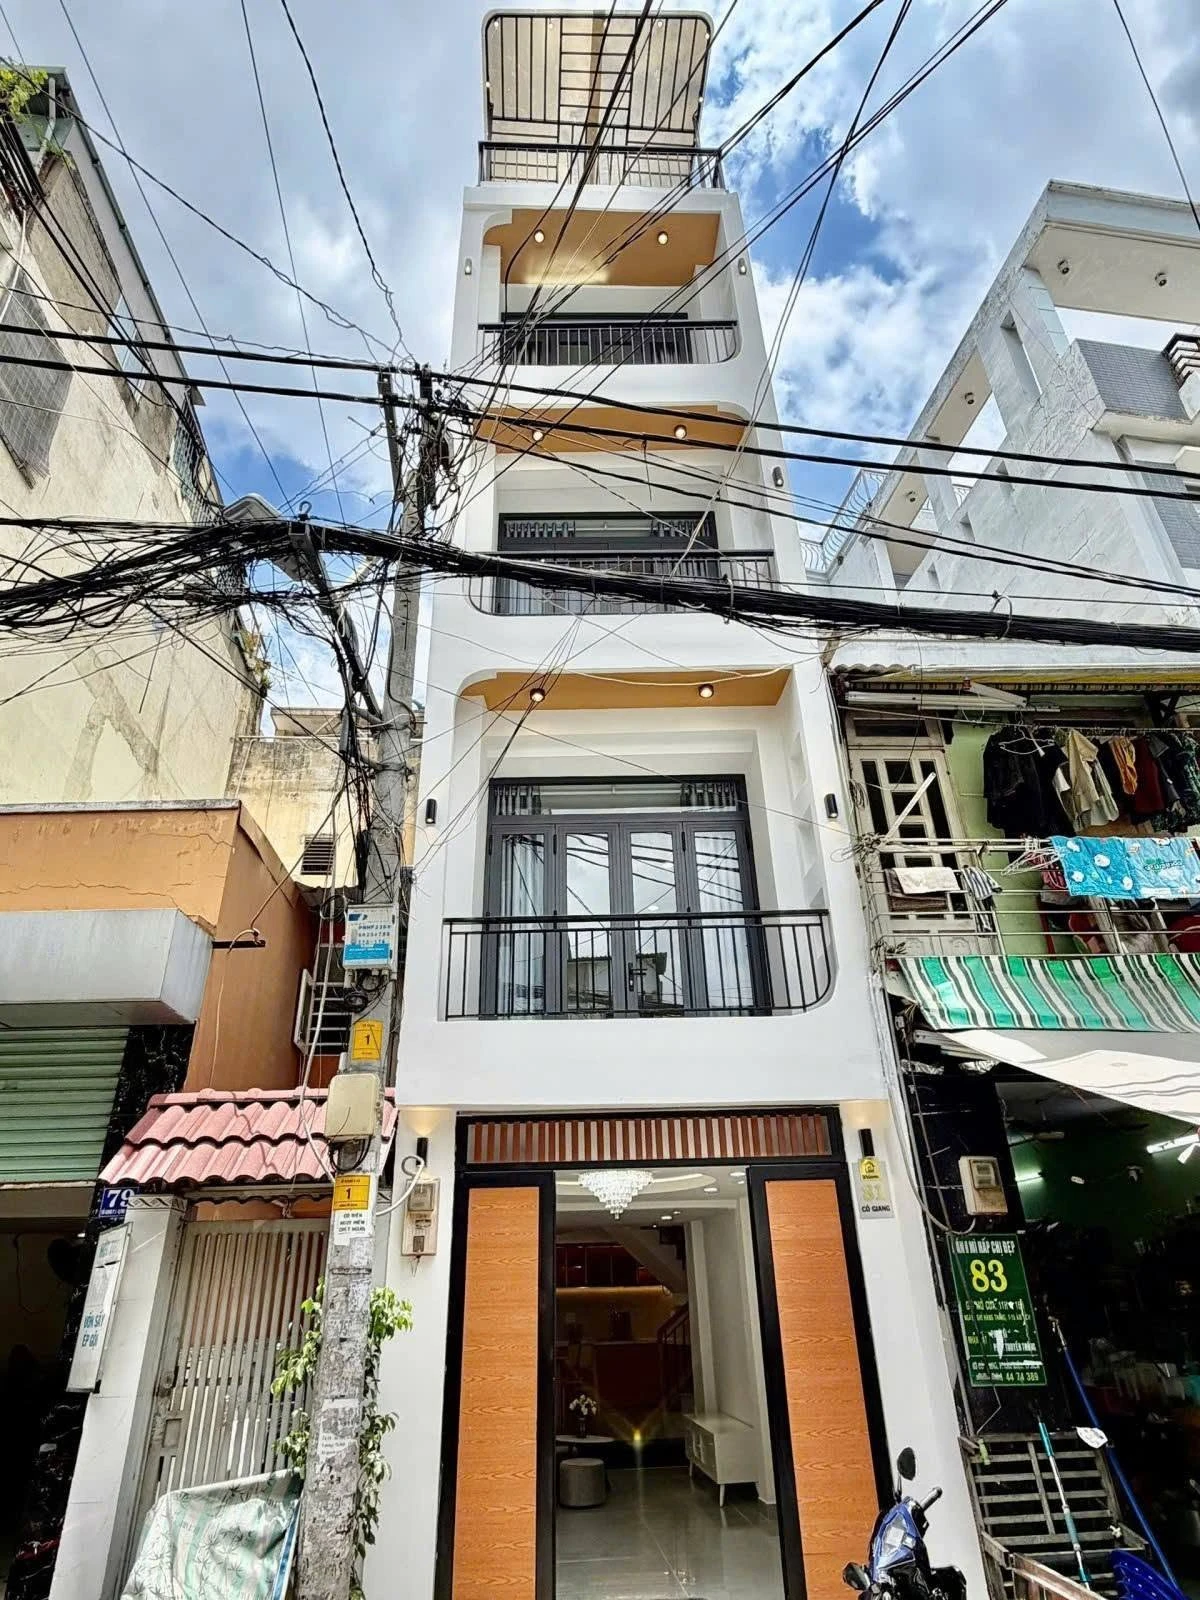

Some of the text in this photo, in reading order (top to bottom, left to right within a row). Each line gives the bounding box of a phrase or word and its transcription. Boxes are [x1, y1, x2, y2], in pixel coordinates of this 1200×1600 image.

[107, 1189, 135, 1208] 79
[346, 1188, 351, 1200] 1
[970, 1259, 1008, 1293] 83
